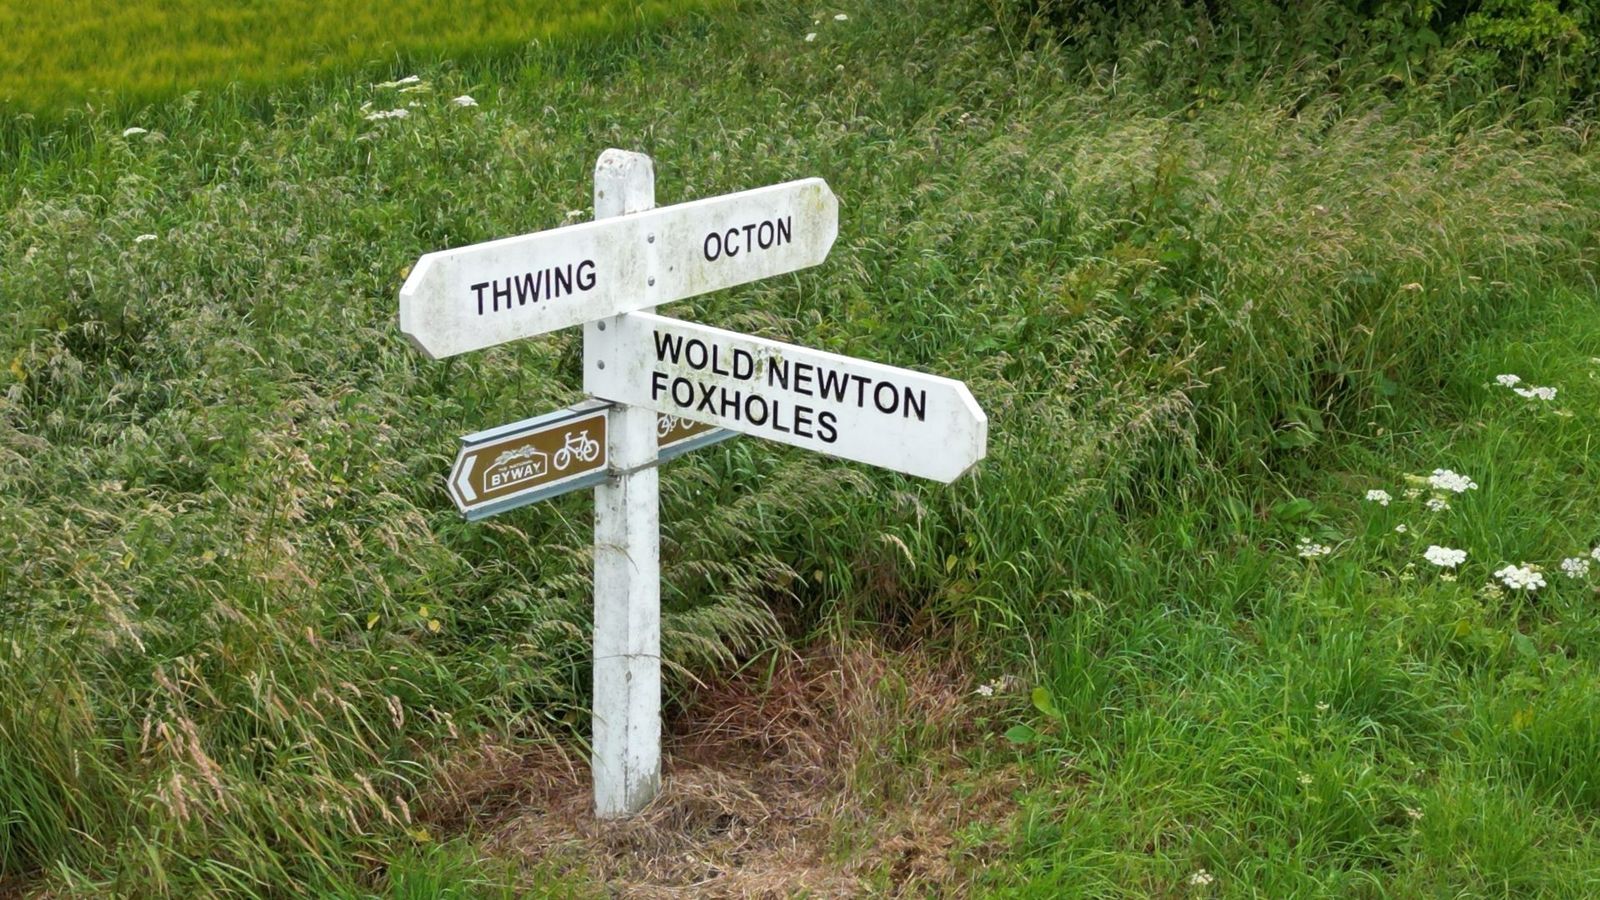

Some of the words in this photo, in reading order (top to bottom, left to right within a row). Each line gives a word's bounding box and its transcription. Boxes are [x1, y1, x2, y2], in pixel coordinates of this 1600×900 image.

[703, 216, 791, 262] OCTON
[470, 259, 596, 315] THWING
[653, 330, 754, 381] WOLD
[768, 356, 926, 421] NEWTON
[652, 371, 838, 444] FOXHOLES
[491, 461, 541, 487] BYWAY
